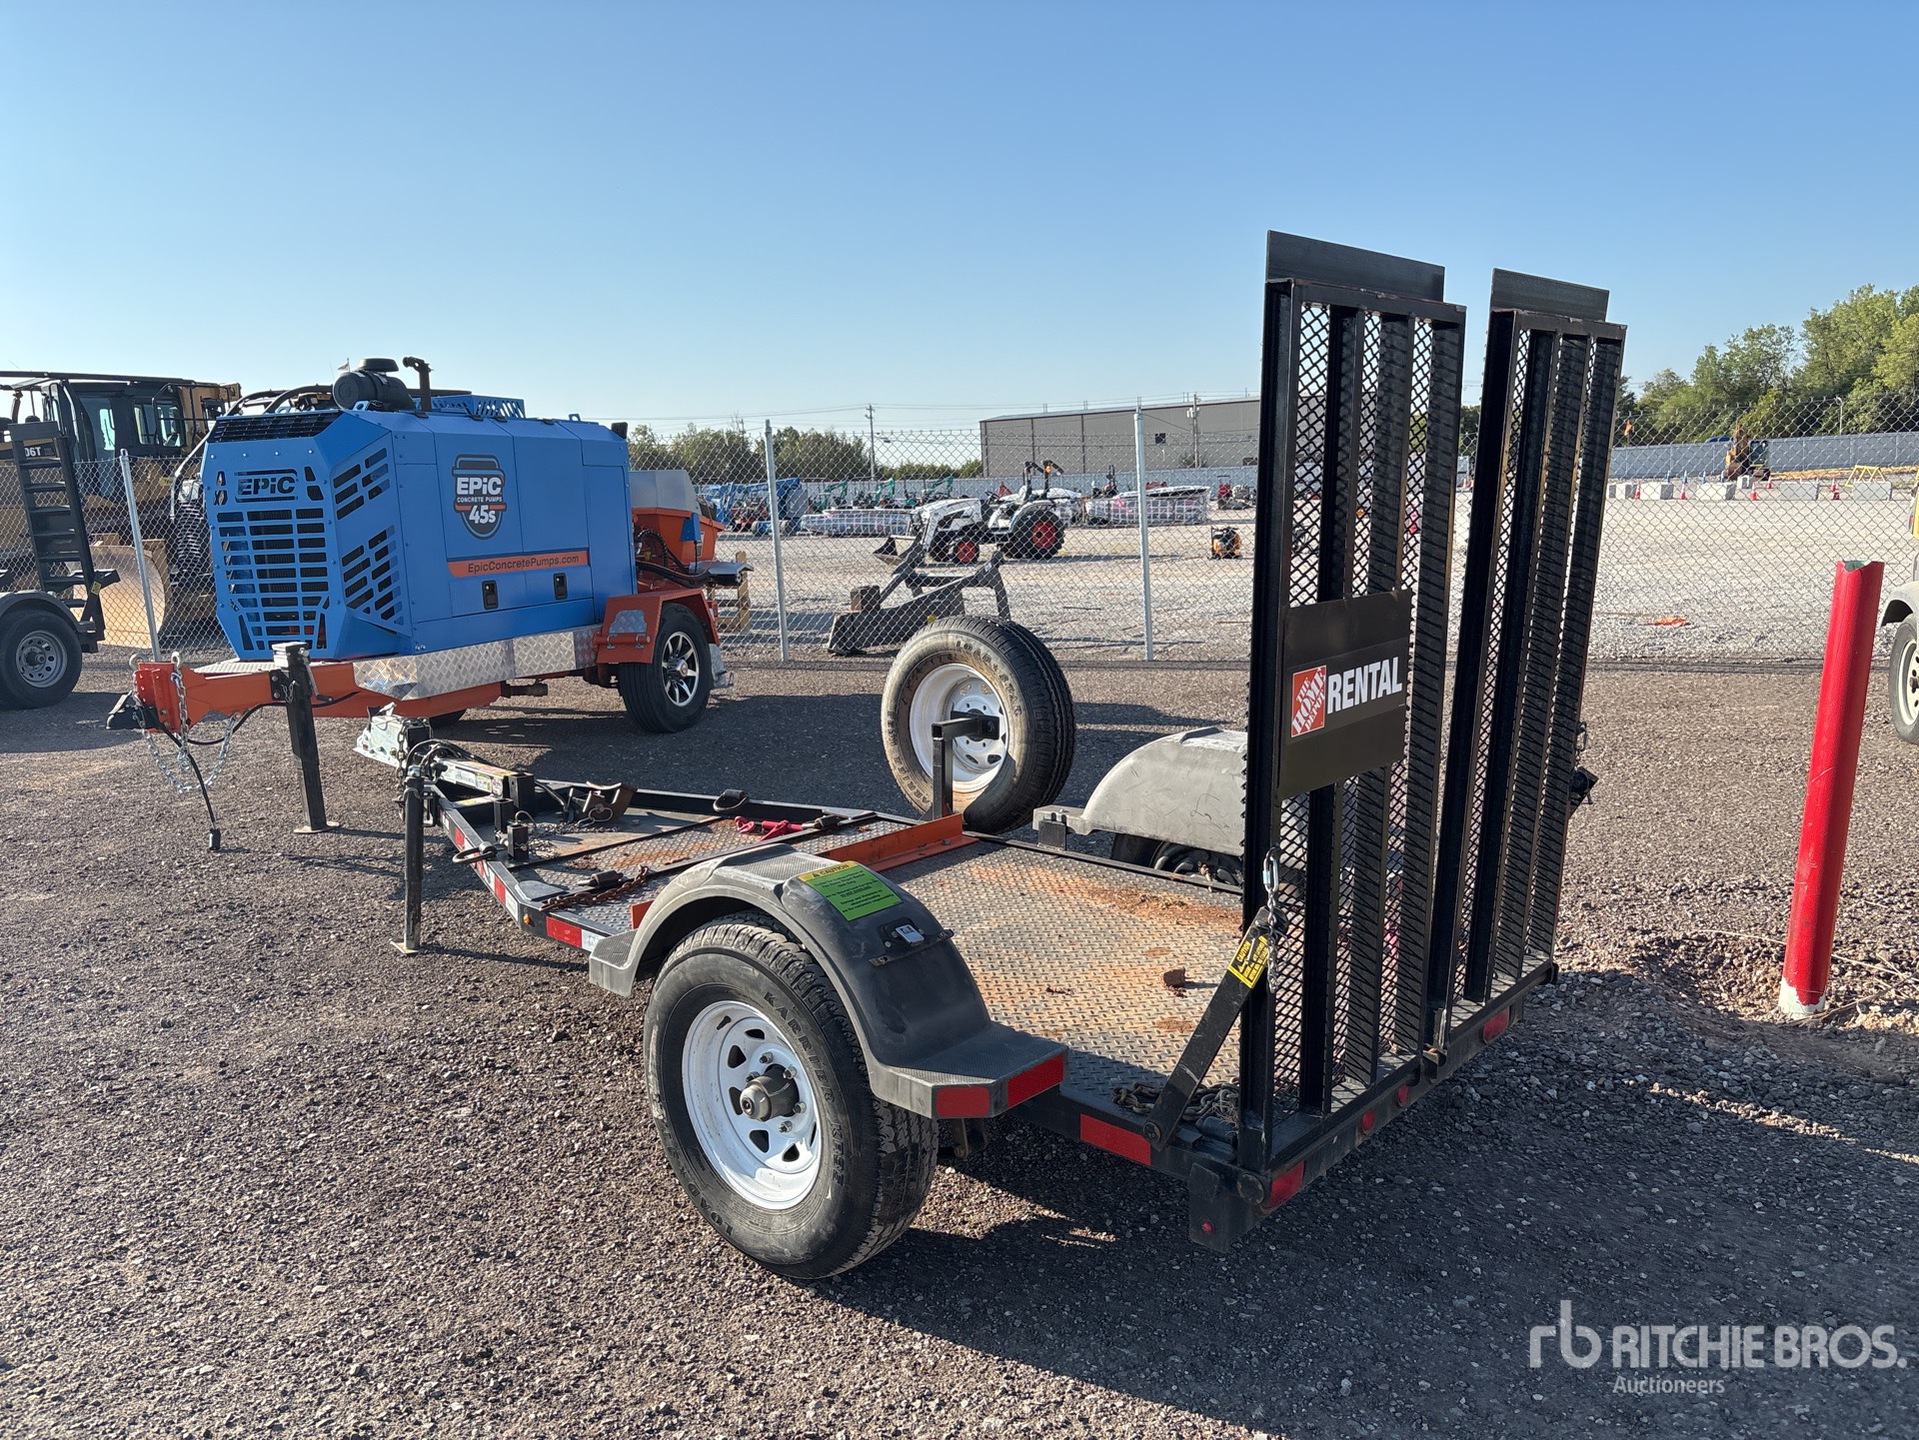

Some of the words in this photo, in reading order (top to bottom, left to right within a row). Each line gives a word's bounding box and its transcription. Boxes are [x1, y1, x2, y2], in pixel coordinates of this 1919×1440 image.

[238, 476, 296, 496] EPiC
[456, 476, 502, 496] EPiC
[468, 504, 497, 525] 45s
[467, 554, 580, 575] EpicConcretePumps.com
[1295, 676, 1311, 703] THE
[1326, 656, 1403, 715] RENTAL
[1291, 667, 1326, 734] HOME
[1304, 689, 1326, 732] DEPOT
[763, 991, 836, 1103] KARRIER
